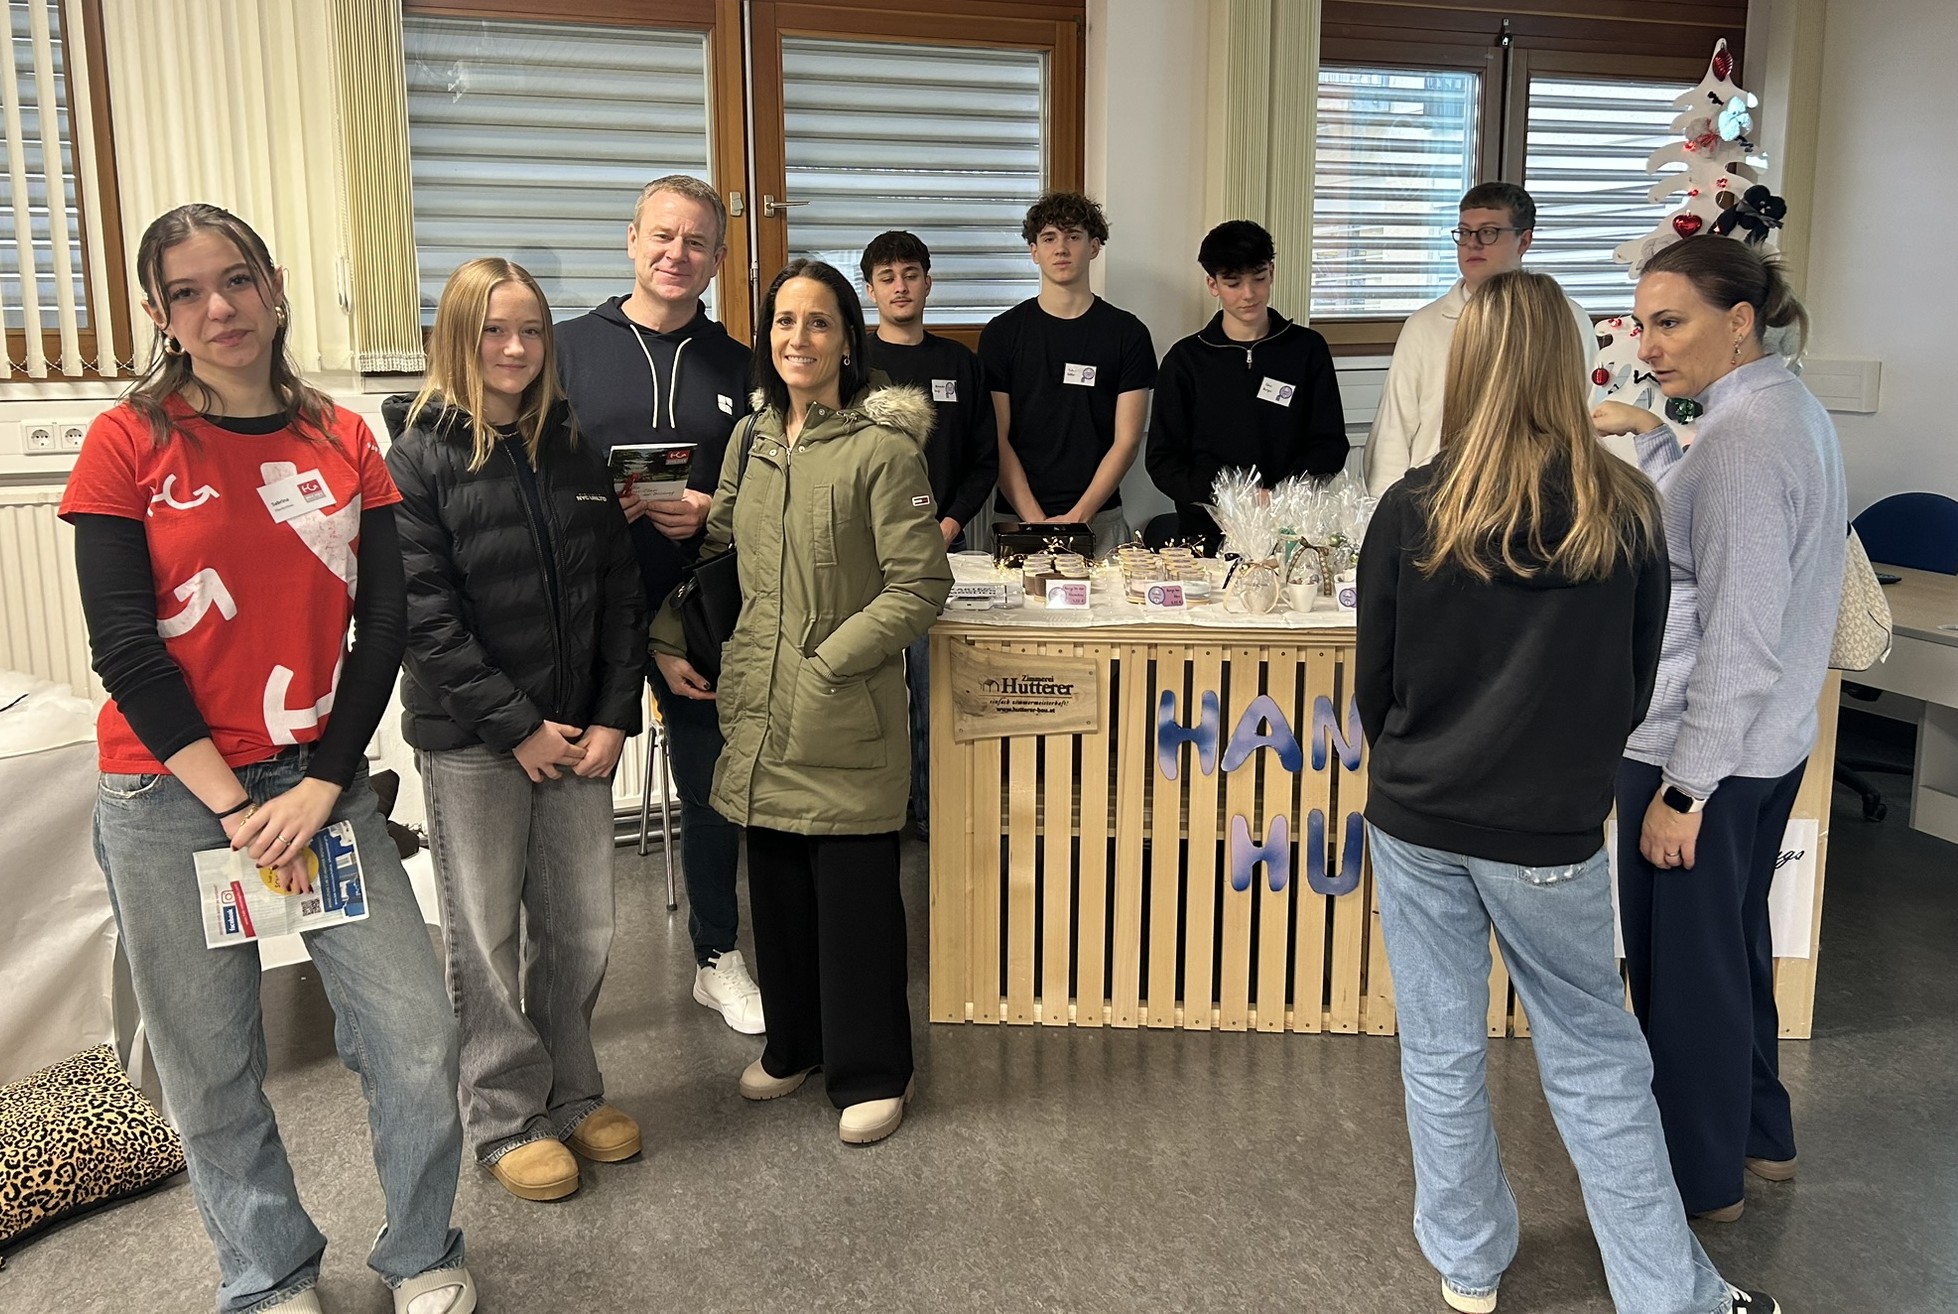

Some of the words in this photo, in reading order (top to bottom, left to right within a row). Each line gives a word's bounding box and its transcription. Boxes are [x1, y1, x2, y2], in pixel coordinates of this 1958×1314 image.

[1001, 677, 1074, 695] Hutterer
[1021, 674, 1054, 682] Zimmerei
[1231, 808, 1364, 896] HU
